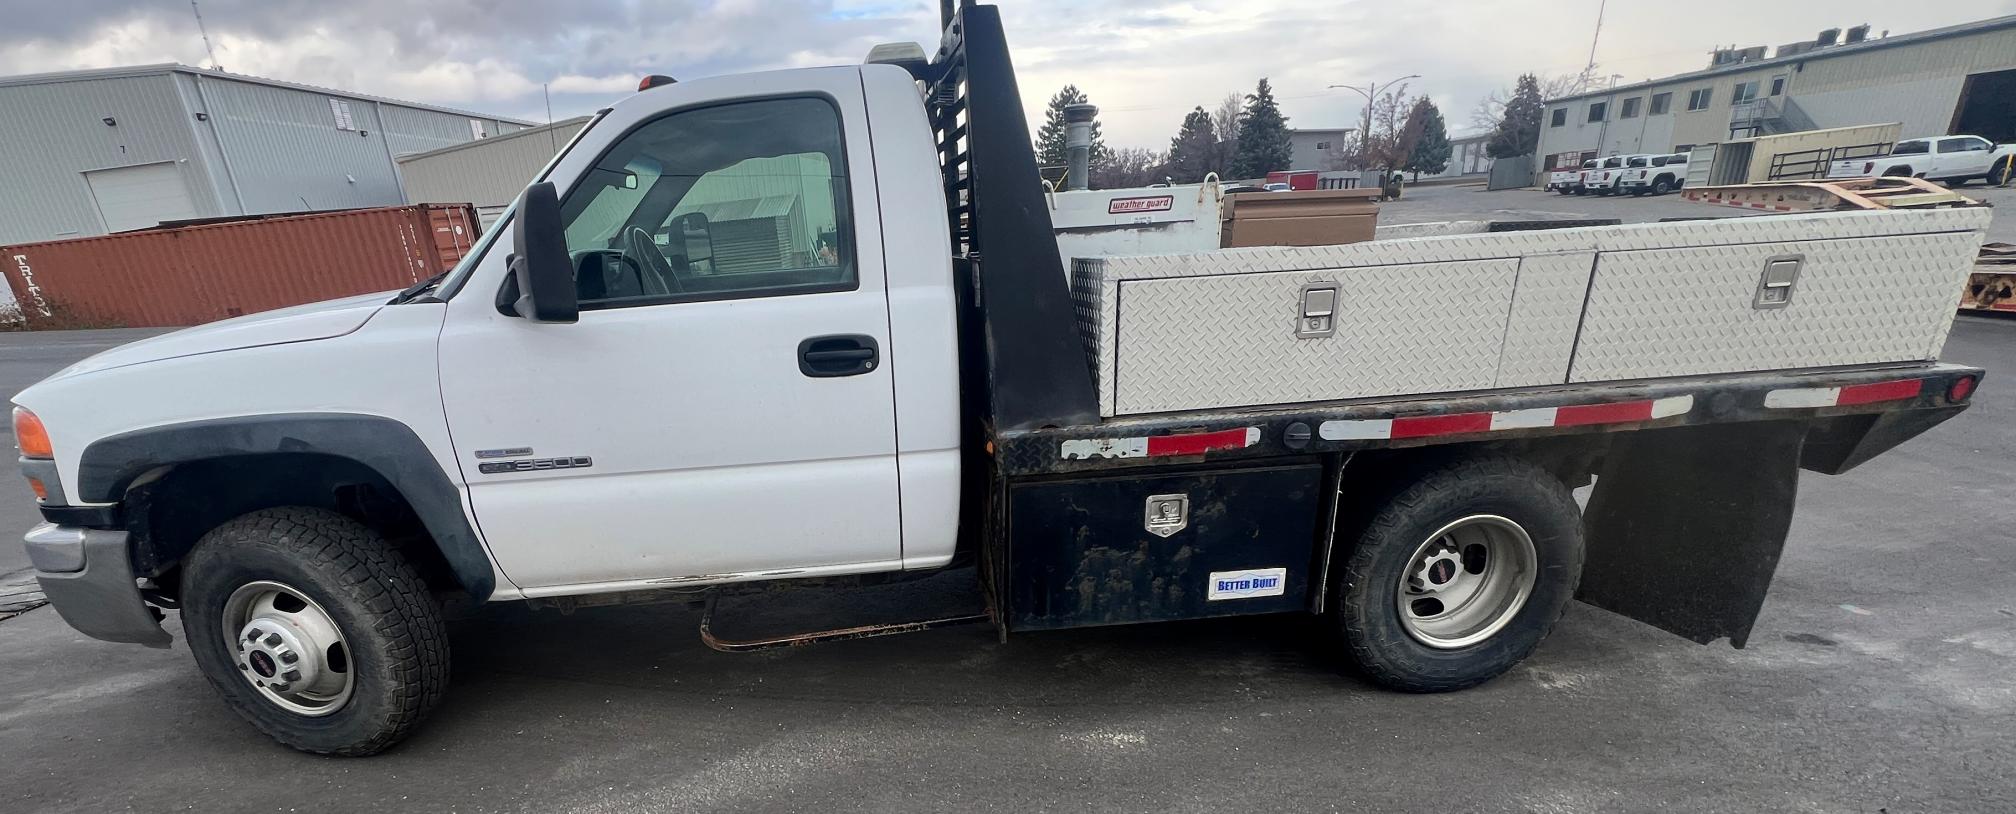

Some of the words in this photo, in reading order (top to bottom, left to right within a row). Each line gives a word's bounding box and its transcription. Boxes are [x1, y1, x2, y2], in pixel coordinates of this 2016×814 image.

[1112, 200, 1145, 209] weather
[1146, 198, 1169, 208] guard
[1218, 580, 1250, 591] BETTER
[1253, 578, 1277, 588] BUILT
